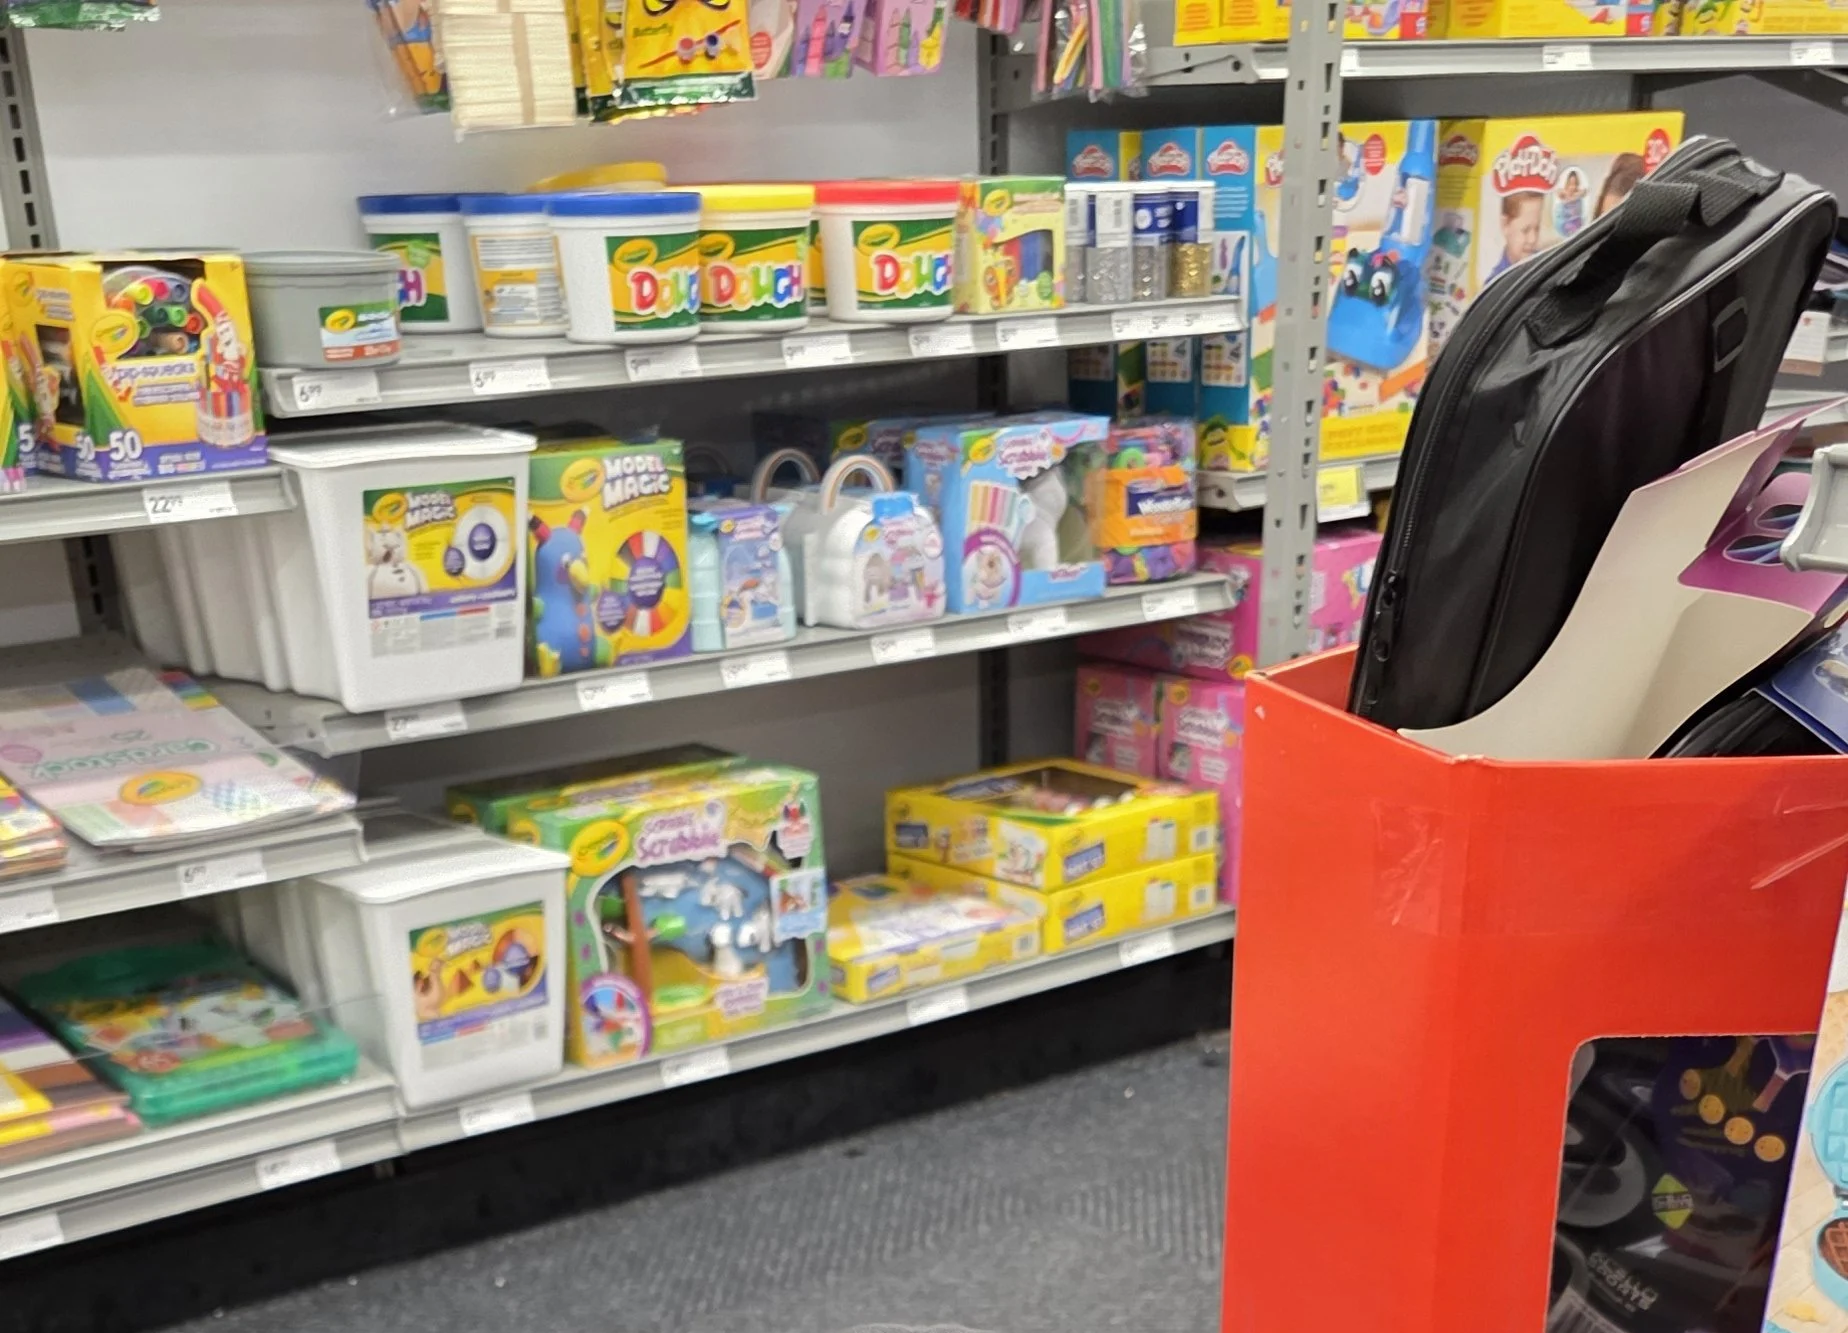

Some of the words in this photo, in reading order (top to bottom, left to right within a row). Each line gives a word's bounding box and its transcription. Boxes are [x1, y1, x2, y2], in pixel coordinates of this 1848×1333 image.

[630, 270, 699, 316] DOUG
[109, 430, 142, 461] 50
[605, 455, 664, 478] MODEL
[603, 473, 671, 509] MAGIC
